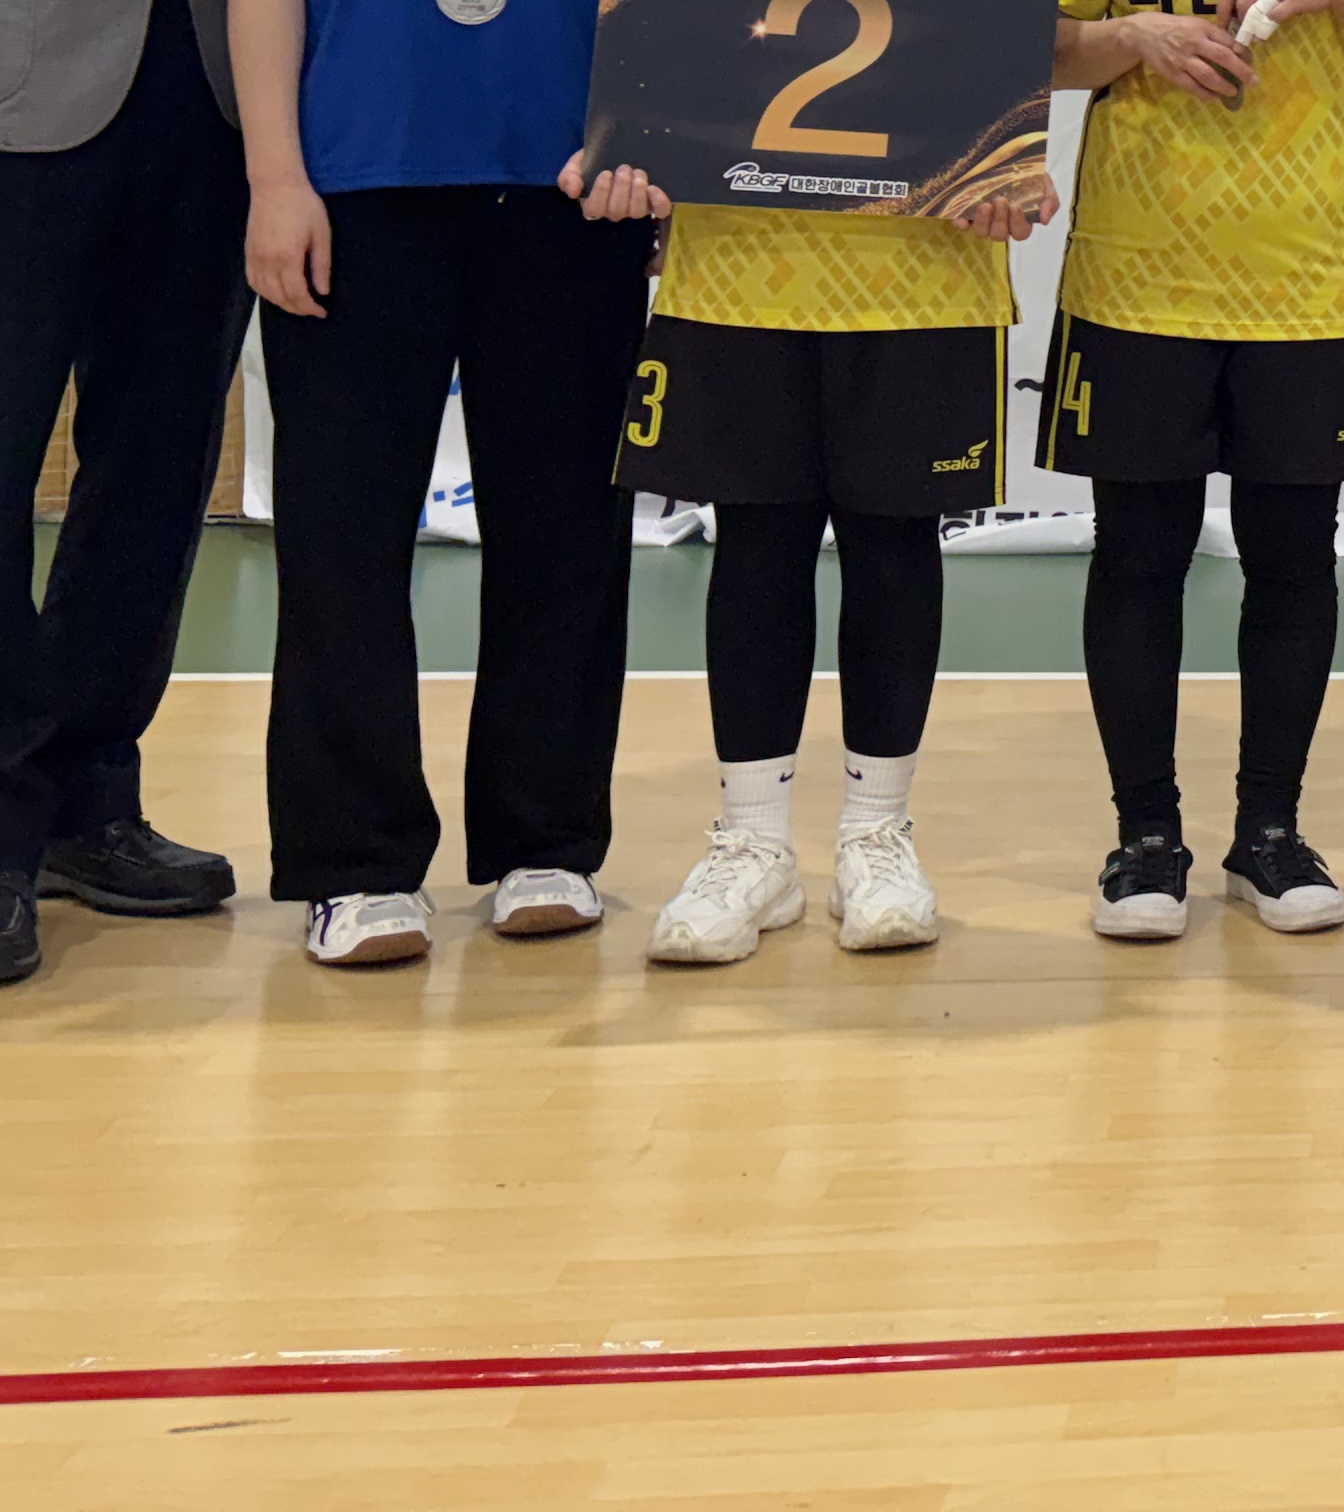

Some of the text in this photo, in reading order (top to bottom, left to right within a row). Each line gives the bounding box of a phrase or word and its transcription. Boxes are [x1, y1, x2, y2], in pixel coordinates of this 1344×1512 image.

[733, 173, 789, 187] KBGF
[627, 360, 668, 447] 3
[1062, 352, 1092, 436] 4
[932, 455, 980, 473] ssaka
